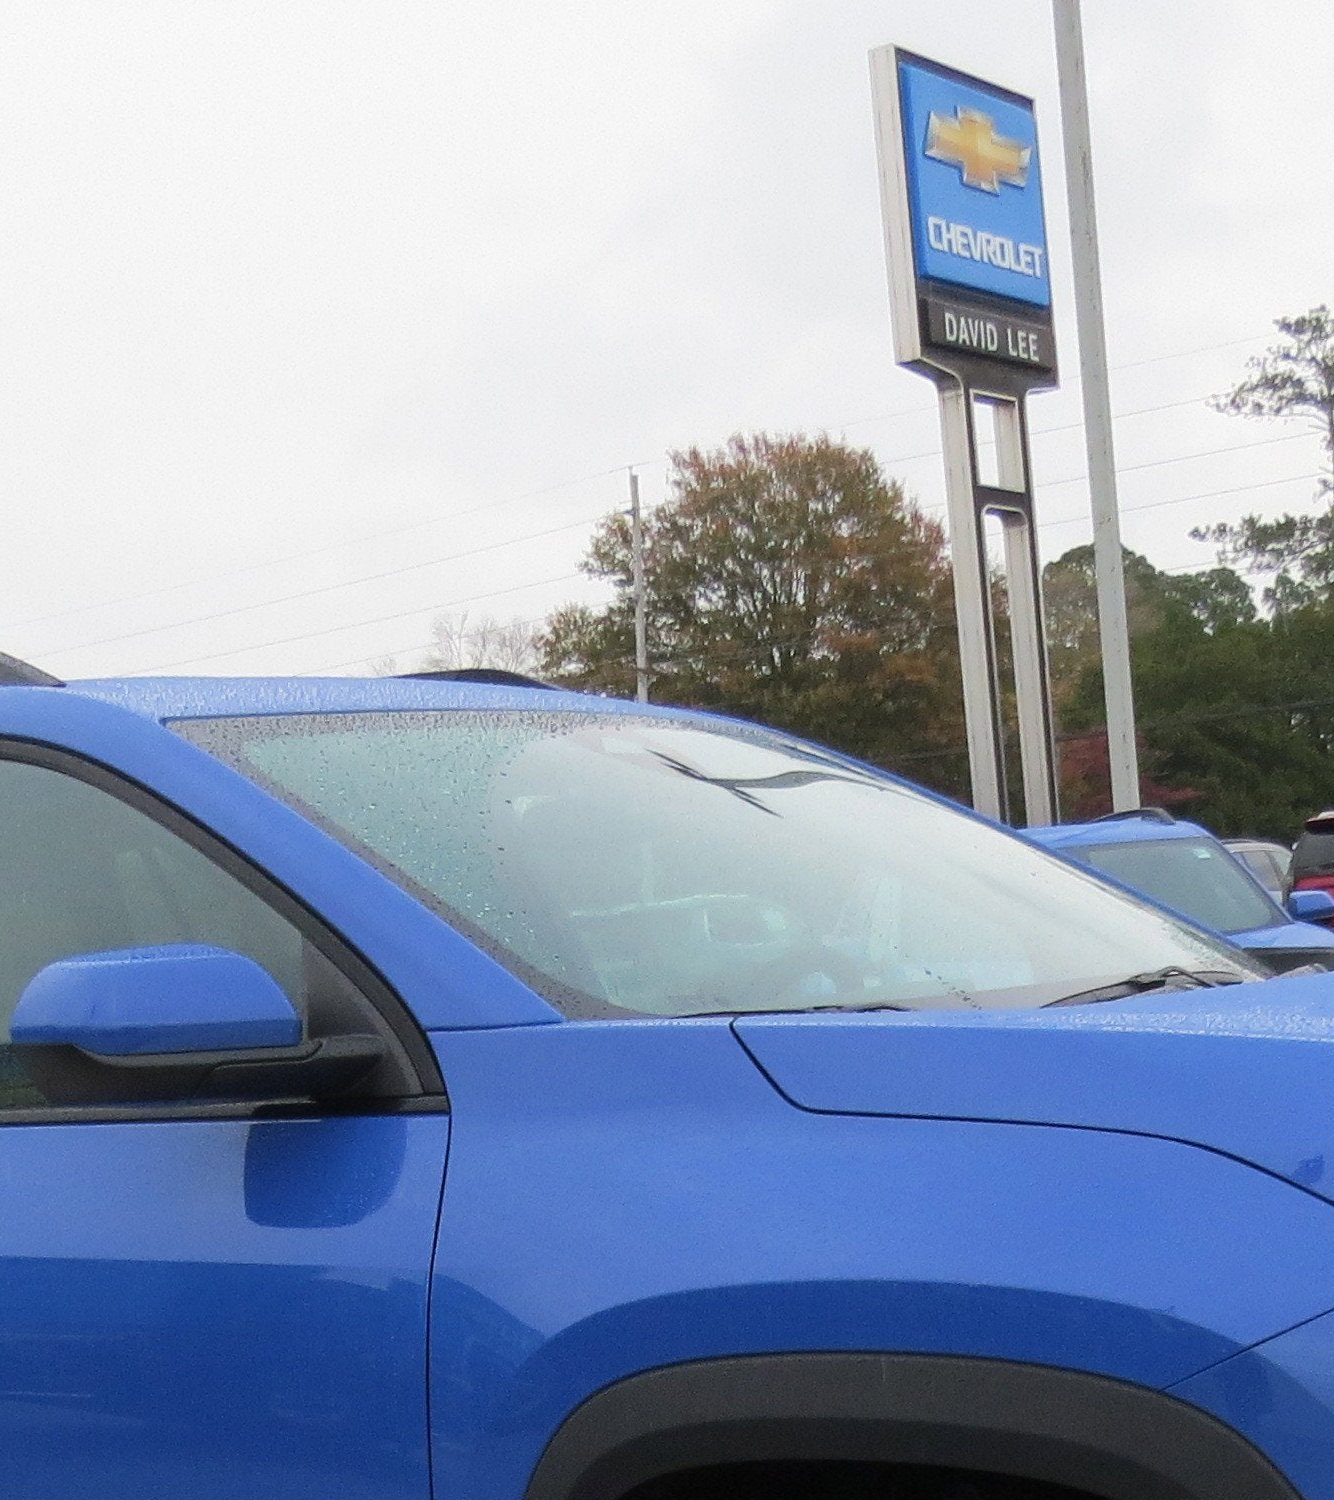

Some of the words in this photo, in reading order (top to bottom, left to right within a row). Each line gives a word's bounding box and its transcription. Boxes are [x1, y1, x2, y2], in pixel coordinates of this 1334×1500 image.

[928, 216, 1044, 278] CHEVROLET
[944, 312, 998, 352] DAVID
[1007, 328, 1040, 362] LEE
